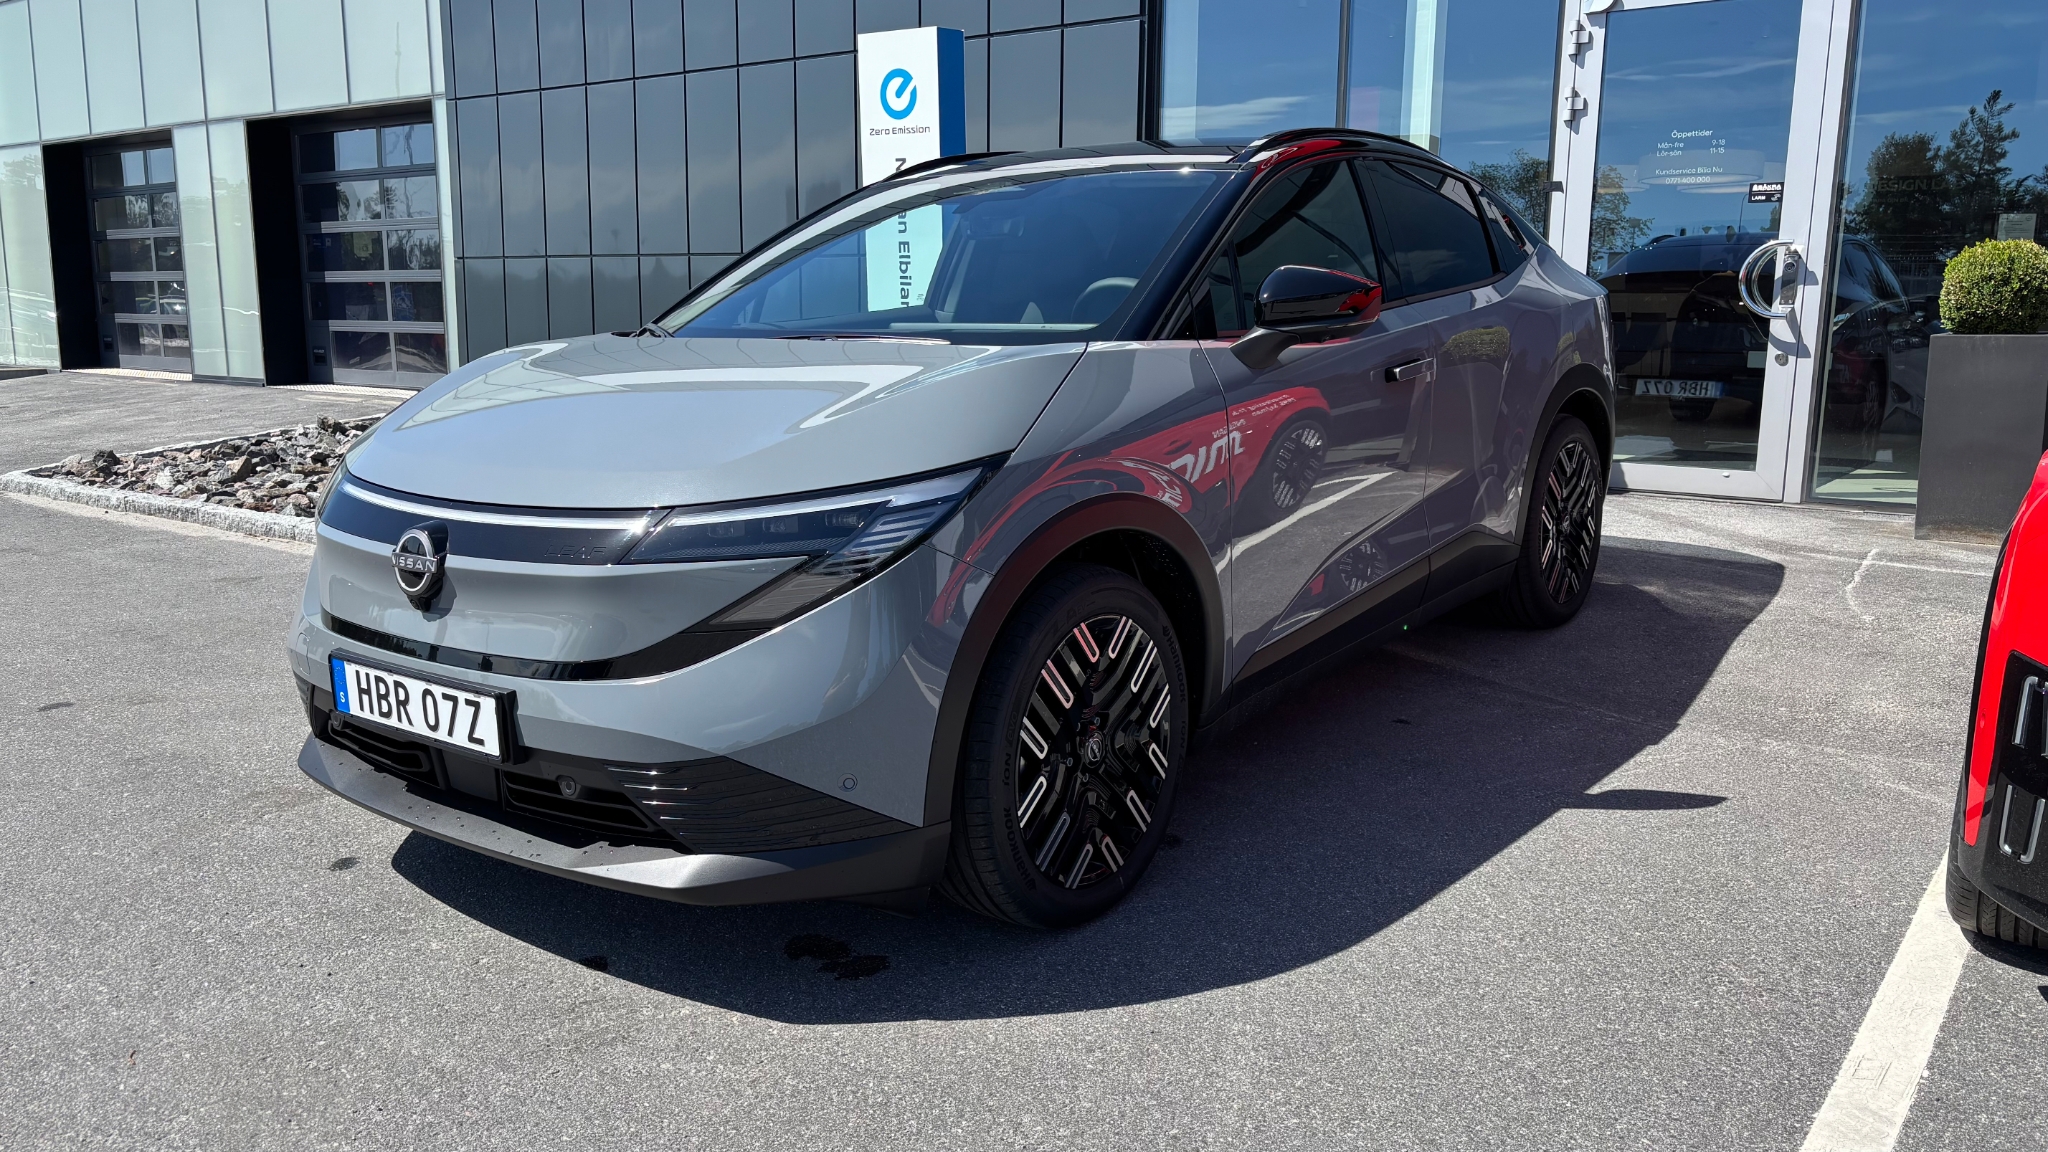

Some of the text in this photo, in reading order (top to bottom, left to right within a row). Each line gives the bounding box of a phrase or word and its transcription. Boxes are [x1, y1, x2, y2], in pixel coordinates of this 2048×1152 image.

[869, 125, 931, 136] Zero Emission
[1671, 129, 1713, 138] Öppettider
[1657, 138, 1726, 149] Mån-fre 9-18
[1697, 166, 1711, 174] Bilia
[544, 544, 607, 559] LEAF
[391, 554, 435, 572] NISSAN
[340, 691, 346, 703] S
[355, 669, 486, 748] HBR 07Z
